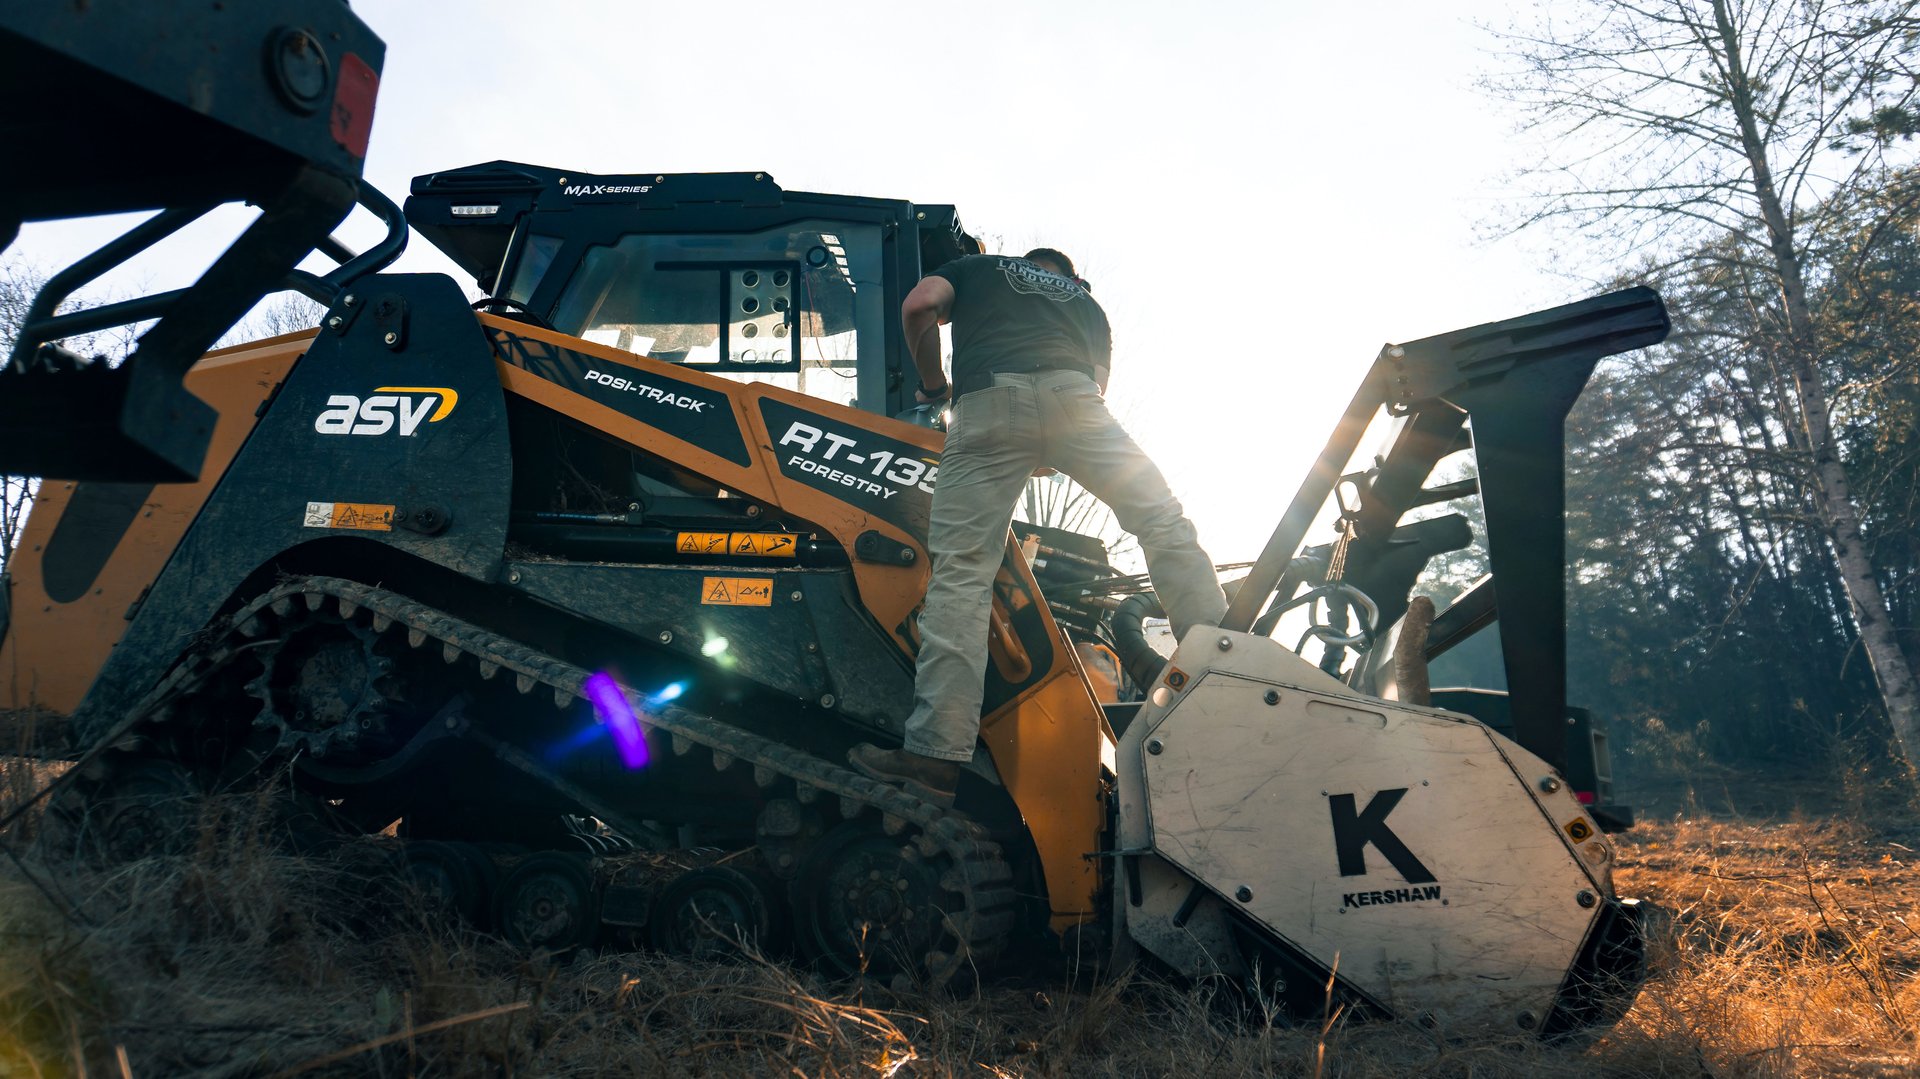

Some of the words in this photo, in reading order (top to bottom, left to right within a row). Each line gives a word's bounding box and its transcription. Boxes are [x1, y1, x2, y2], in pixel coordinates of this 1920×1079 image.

[999, 260, 1085, 297] LANDWORX
[584, 370, 706, 412] POSI-TRACK
[788, 456, 898, 499] FORESTRY
[1329, 788, 1438, 884] K
[1343, 886, 1441, 908] KERSHAW
